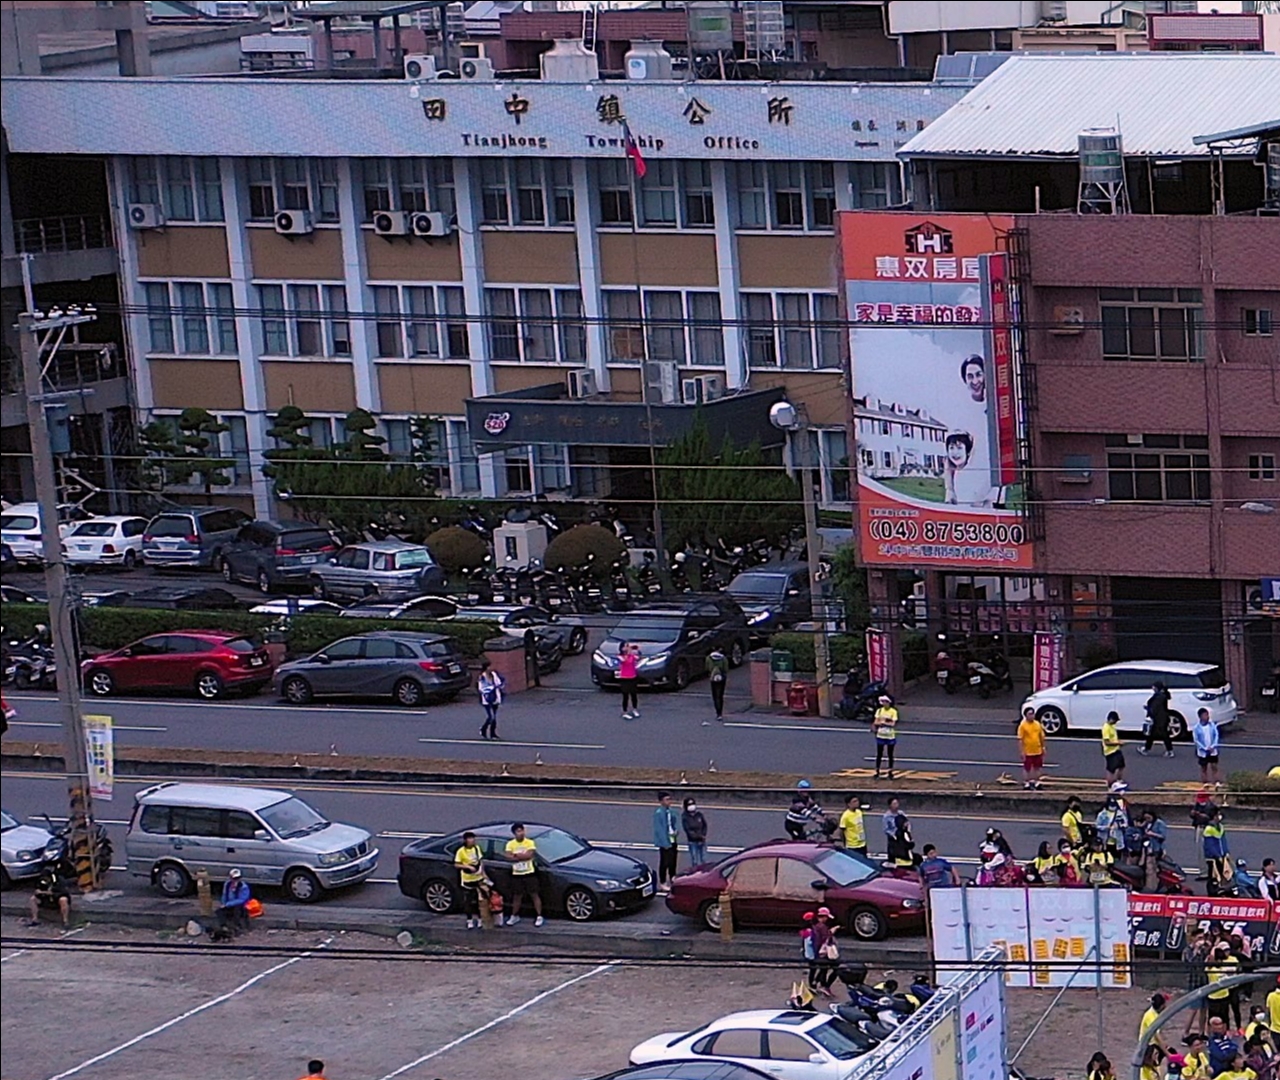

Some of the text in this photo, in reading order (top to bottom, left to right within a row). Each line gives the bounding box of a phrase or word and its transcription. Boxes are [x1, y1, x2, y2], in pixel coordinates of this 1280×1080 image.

[421, 92, 795, 127] 田中鎮公所
[460, 132, 760, 152] Tianjhong Townhip Office
[922, 520, 1026, 545] 8753800
